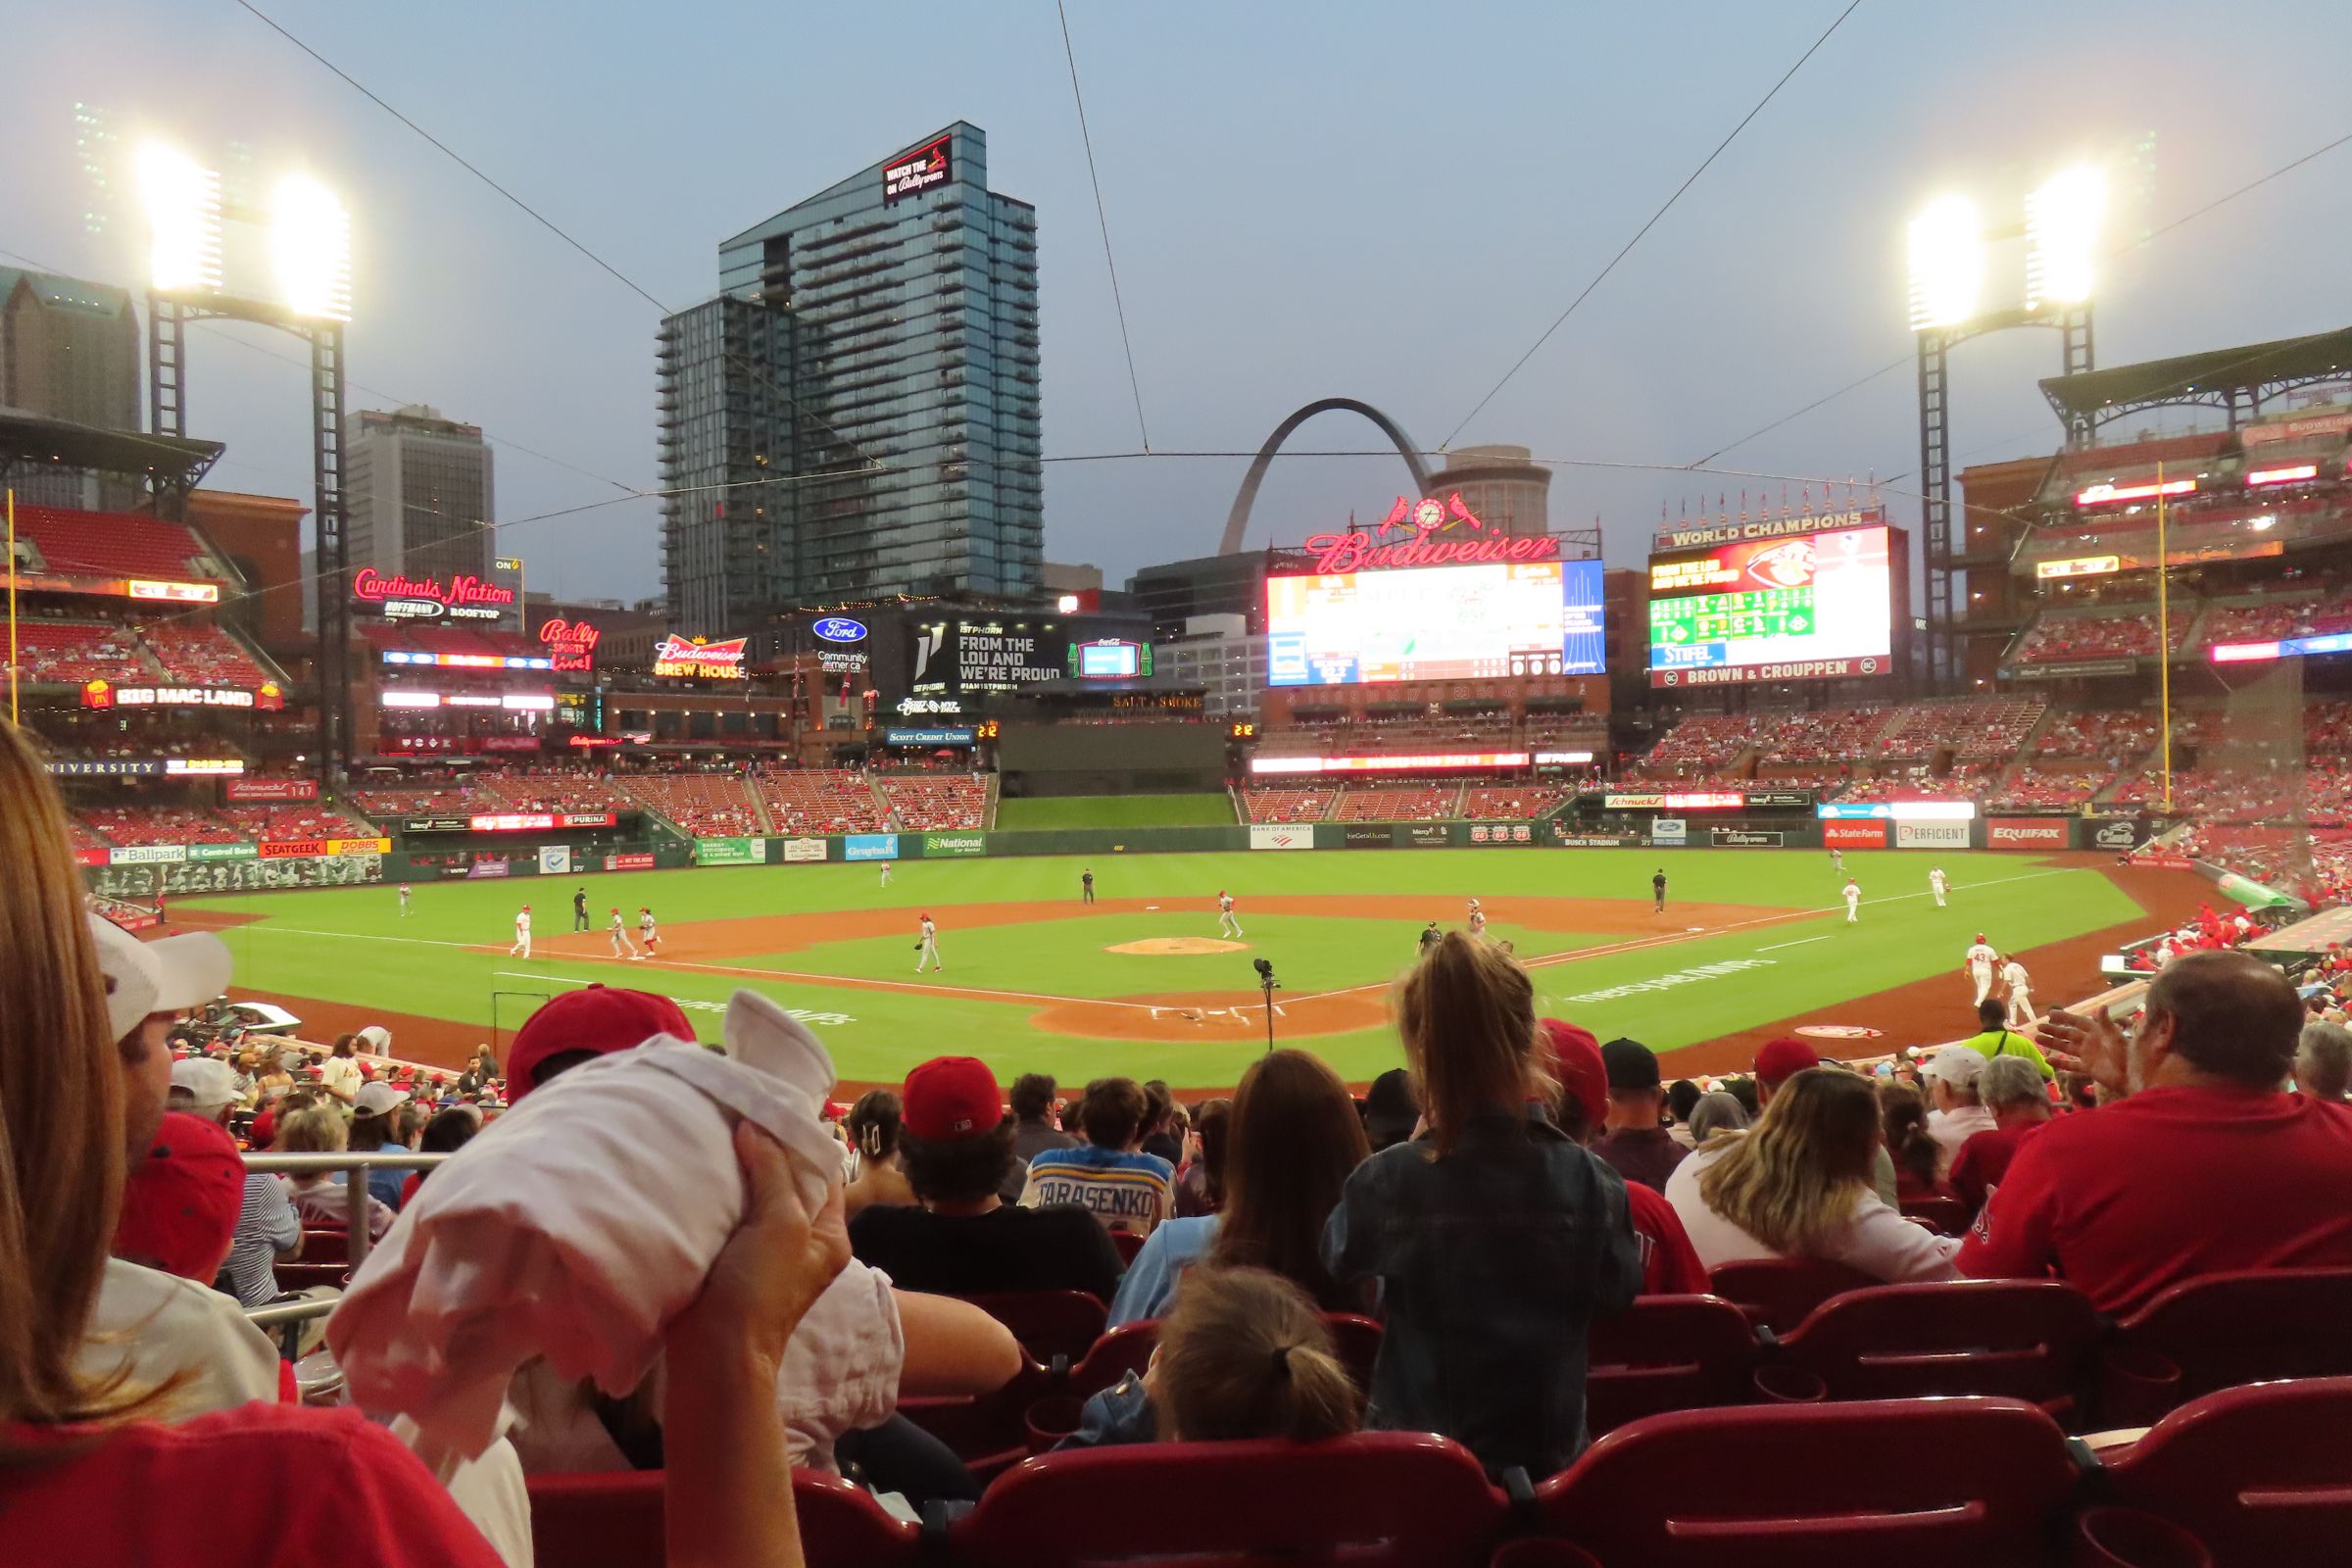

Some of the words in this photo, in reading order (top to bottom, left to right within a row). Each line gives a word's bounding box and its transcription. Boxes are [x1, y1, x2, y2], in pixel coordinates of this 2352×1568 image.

[886, 165, 911, 181] WATCH
[912, 160, 927, 173] THE
[887, 184, 897, 195] ON
[899, 173, 924, 191] Bally
[924, 172, 944, 183] SPORTS
[1672, 528, 1740, 546] WORLD
[1744, 512, 1862, 538] CHAMPIONS
[1304, 527, 1560, 574] Budweiser
[354, 567, 442, 600] Cardinals
[441, 575, 514, 605] Nation
[384, 601, 434, 614] HOFFMANN
[450, 608, 500, 619] ROOFTOP
[540, 617, 601, 649] Bally
[825, 621, 858, 639] Ford
[553, 643, 585, 654] SPORTS
[655, 642, 745, 660] Budweiser
[959, 636, 1004, 652] FROM
[1006, 638, 1035, 652] THE
[817, 651, 868, 663] Community
[959, 652, 989, 665] LOU
[992, 654, 1024, 667] AND
[1664, 646, 1713, 662] STIFEL
[551, 654, 592, 671] Live!
[1862, 662, 1875, 670] BC
[655, 662, 697, 676] BREW
[699, 665, 746, 678] HOUSE
[959, 666, 1007, 680] WE'RE
[1011, 667, 1060, 681] PROUD
[1688, 667, 1742, 683] BROWN
[1746, 669, 1757, 679] &
[1760, 662, 1848, 679] CROUPPEN
[1666, 673, 1677, 683] BC
[117, 689, 155, 704] BIG
[157, 689, 203, 704] MAC
[204, 690, 253, 707] LAND
[1113, 697, 1147, 708] SALT
[1159, 696, 1201, 708] SMOKE
[978, 725, 997, 737] 2:12
[45, 762, 155, 773] NIVERSITY
[232, 782, 289, 791] Schnucks
[1608, 796, 1661, 806] Schnucks
[1727, 834, 1750, 845] Bally
[1898, 826, 1966, 841] PERFICIENT
[1992, 827, 2061, 841] EQUIFAX
[265, 843, 319, 856] SEATGEEK
[340, 841, 378, 851] DOBBS
[939, 838, 983, 849] National
[128, 849, 185, 861] Ballpark
[201, 849, 234, 858] Central
[234, 847, 258, 856] Bank
[1974, 953, 1985, 962] 43
[1038, 1182, 1153, 1218] TARASENKO
